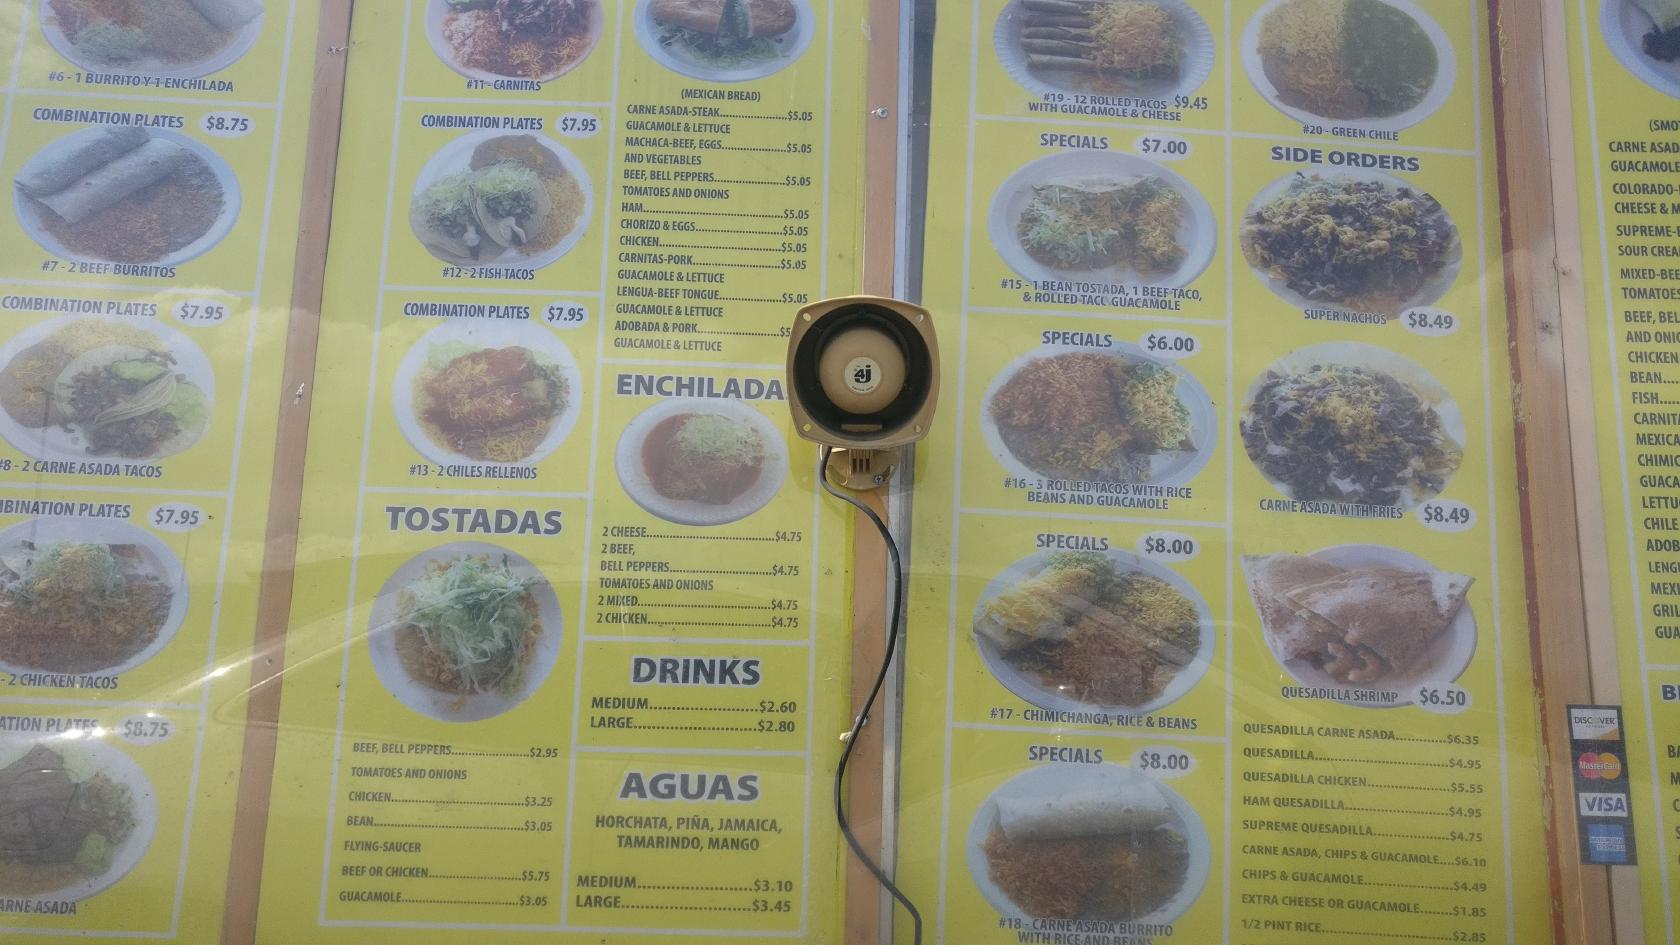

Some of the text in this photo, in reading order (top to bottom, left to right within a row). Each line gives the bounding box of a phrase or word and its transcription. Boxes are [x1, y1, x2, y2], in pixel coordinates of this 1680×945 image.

[48, 72, 234, 92] #6 1 BURRITO Y 1 ENCHILADA
[467, 79, 542, 91] #11 CARNITAS
[681, 88, 761, 103] (MEXICAN BREAD)
[1043, 92, 1168, 110] #19 12 ROLLED TACOS
[1174, 94, 1208, 110] $9.45
[33, 107, 184, 128] COMBINATION PLATES
[627, 104, 657, 115] CARNE
[1028, 102, 1182, 121] WITH GUACAMOLE & CHEESE
[206, 115, 249, 132] $8.75
[421, 114, 543, 130] COMBINATION PLATES
[561, 118, 597, 132] $7.95
[626, 120, 731, 134] GUACAMOLE & LETTUCE
[1303, 124, 1399, 141] #20 GREEN CHILE
[1040, 133, 1109, 150] SPECIALS
[1142, 137, 1187, 155] $7.00
[1609, 141, 1647, 153] CARNE
[624, 153, 702, 165] AND VEGETABLES
[1271, 146, 1420, 172] SIDE ORDERS
[1618, 245, 1649, 256] SOUR
[42, 261, 176, 278] #7 2 BEEF BURRITOS
[442, 267, 535, 280] #12 2 FISH TACOS
[2, 296, 157, 317] COMBINATION PLATES
[180, 303, 223, 320] $7.95
[404, 302, 530, 320] COMBINATION PLATES
[547, 307, 584, 322] $7.95
[1304, 309, 1387, 325] SUPER NACHOS
[1408, 311, 1453, 329] $8.49
[1624, 310, 1656, 325] BEEF,
[1042, 330, 1113, 348] SPECIALS
[1147, 334, 1194, 352] $6.00
[1626, 331, 1651, 343] AND
[1628, 351, 1679, 364] CHICKEN
[617, 374, 787, 400] ENCHILADA
[22, 461, 30, 472] 2
[33, 461, 76, 474] CARNE
[78, 463, 120, 476] ASADA
[124, 465, 163, 478] TACOS
[410, 465, 537, 480] #13 2 CHILES RELLENOS
[155, 507, 199, 525] $7.95
[1259, 499, 1403, 519] CARNE ASADA WITH FRIES
[1424, 503, 1470, 524] $8.49
[386, 506, 562, 535] TOSTADAS
[1644, 517, 1679, 530] CHILE
[602, 527, 609, 536] 2
[1036, 534, 1109, 551] SPECIALS
[1145, 536, 1194, 555] $8.00
[600, 578, 714, 591] TOMATOES AND ONIONS
[632, 657, 760, 685] DRINKS
[1281, 686, 1398, 703] QUESADILLA SHRIMP
[1419, 687, 1466, 706] $6.50
[990, 708, 1197, 729] #17 CHIMICHANGA, RICE & BEANS
[123, 719, 169, 737] $8.75
[1028, 745, 1103, 764] SPECIALS
[1139, 751, 1189, 770] $8.00
[351, 767, 467, 780] TOMATOES AND ONIONS
[1243, 771, 1315, 785] QUESADILLA
[619, 772, 759, 801] AGUAS
[1243, 796, 1270, 807] HAM
[1585, 797, 1626, 813] VISA
[595, 815, 782, 834] HORCHATA, PIÑA, JAMAICA,
[344, 841, 421, 853] FLYING-SAUCER
[617, 835, 759, 852] TAMARINDO, MANGO
[1242, 869, 1277, 881] CHIPS
[1280, 870, 1289, 882] &
[999, 917, 1173, 936] #18 CARNE ASADA BURRITO
[1241, 919, 1261, 930] 1/2
[1264, 921, 1291, 932] PINT
